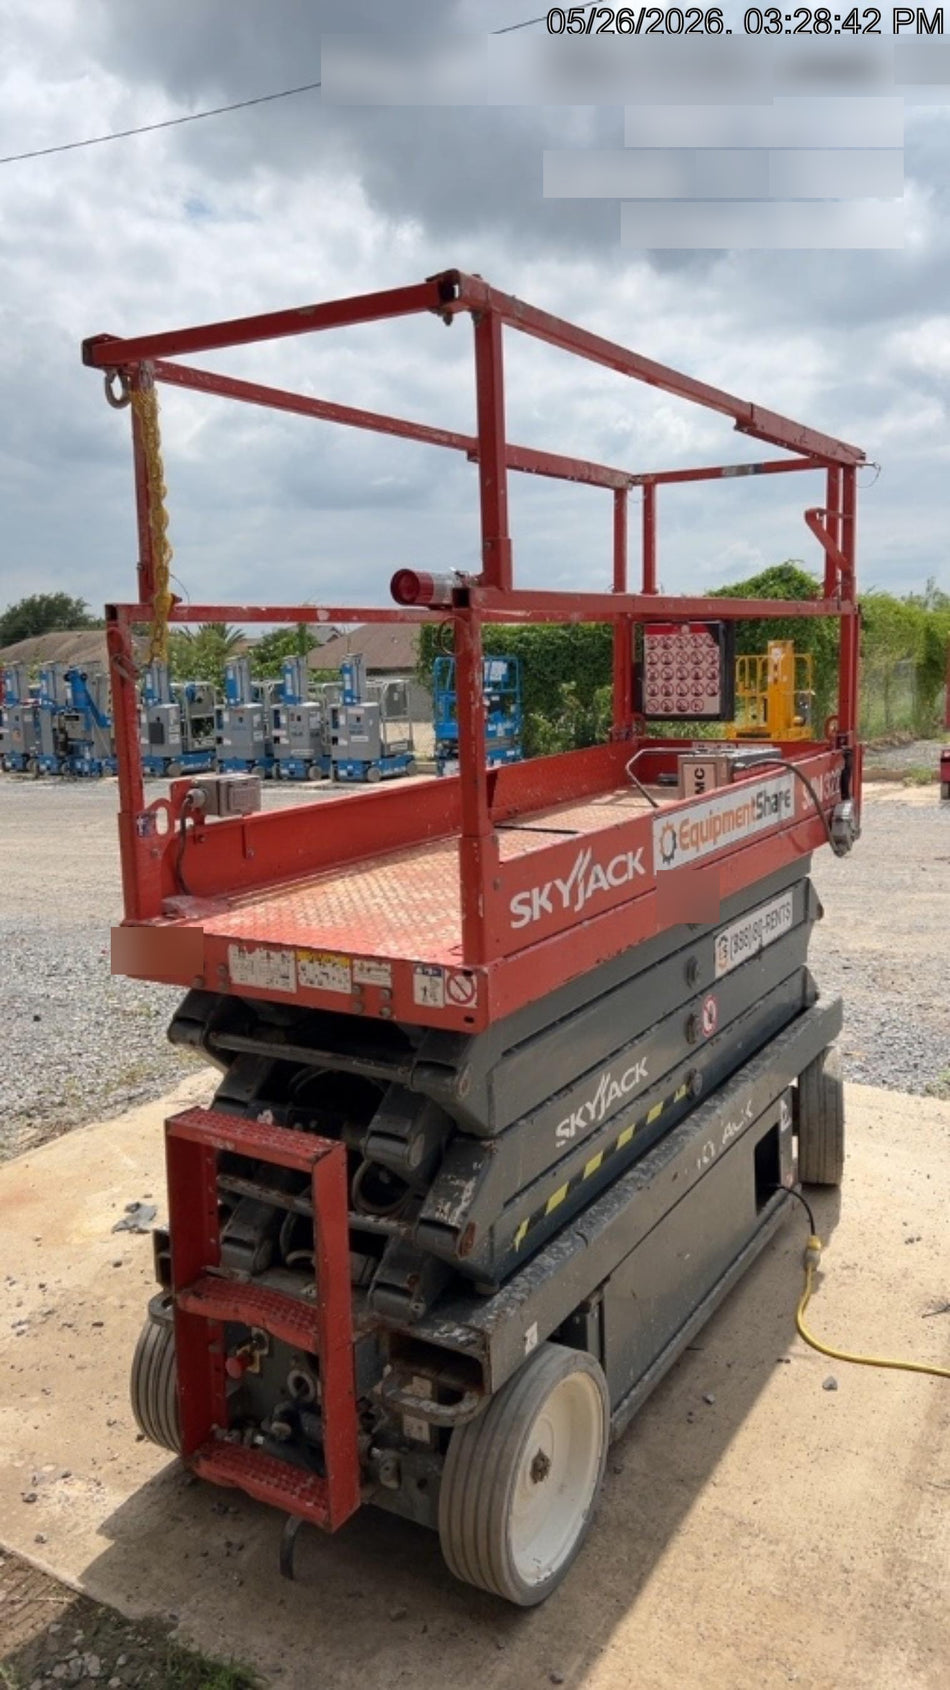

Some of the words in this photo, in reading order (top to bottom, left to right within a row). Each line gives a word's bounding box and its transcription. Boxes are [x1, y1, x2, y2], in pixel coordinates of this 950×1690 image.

[679, 788, 791, 853] EquipmentShare
[509, 846, 646, 930] SKYJACK
[555, 1056, 649, 1148] SKYJACK
